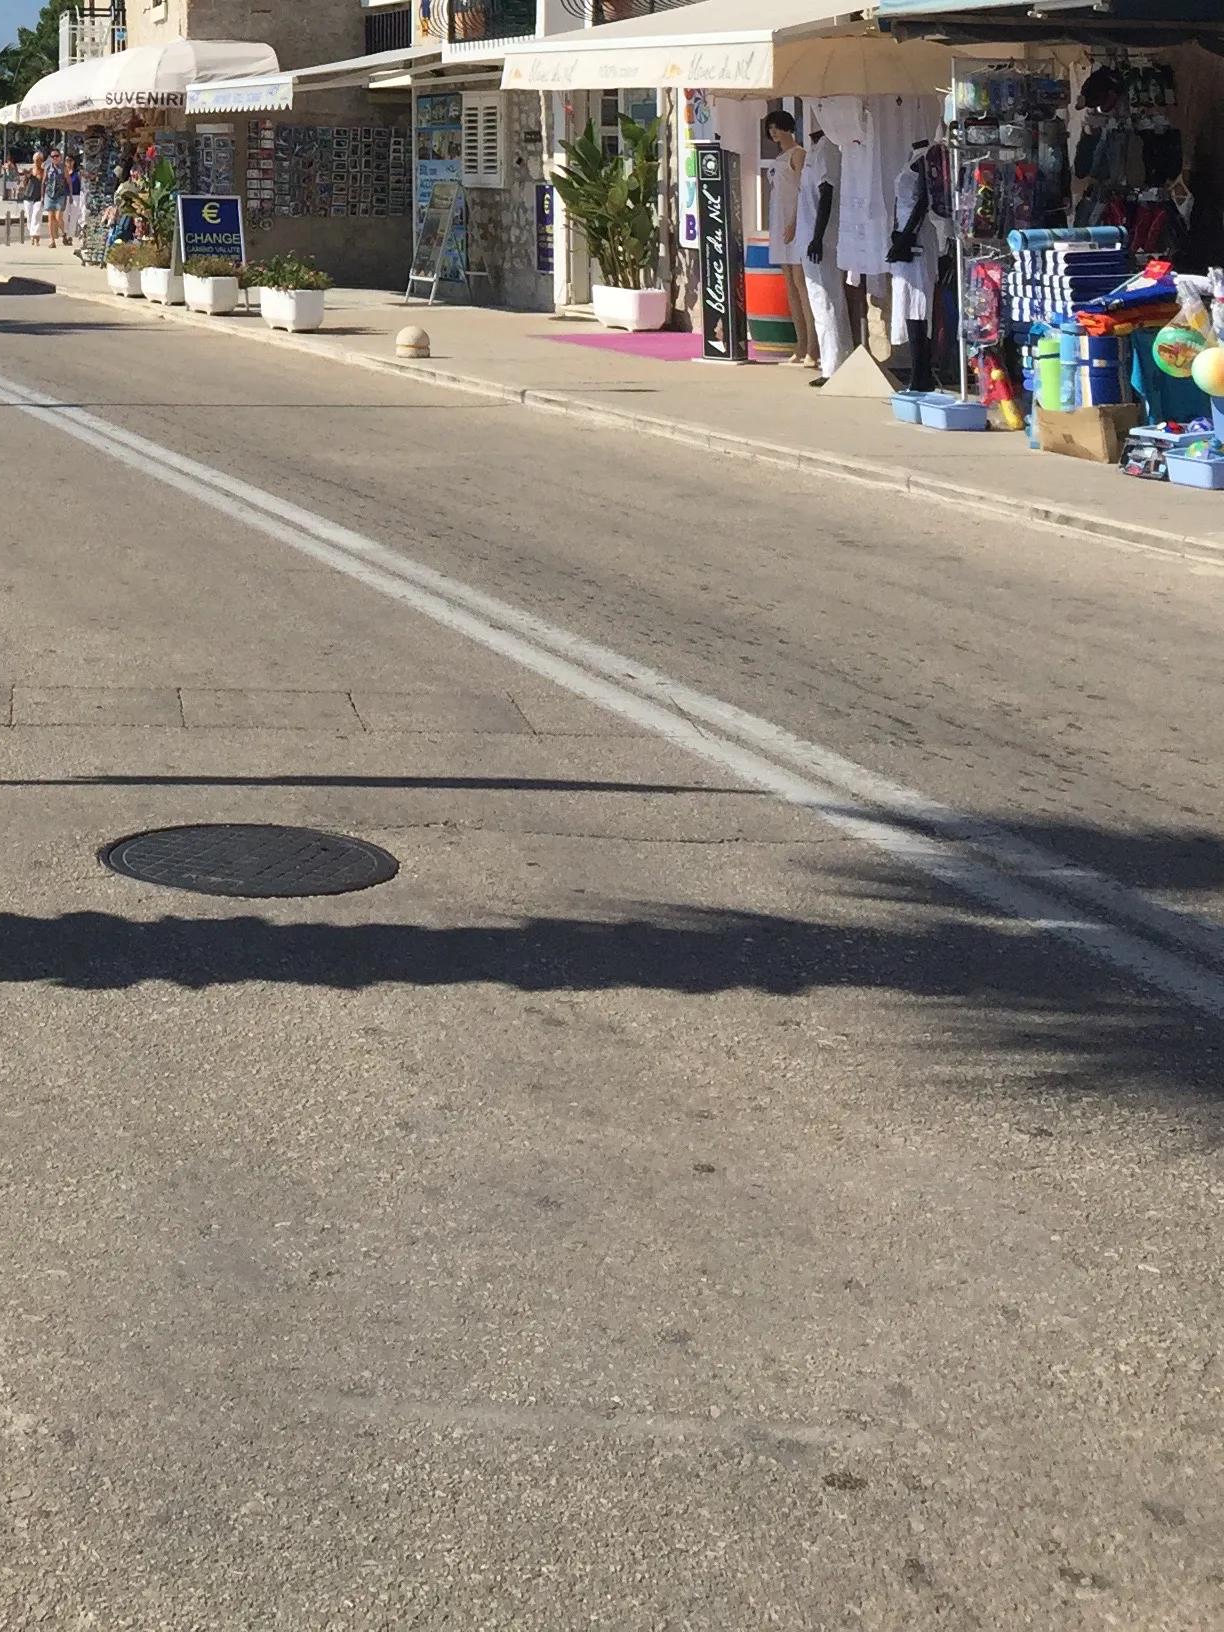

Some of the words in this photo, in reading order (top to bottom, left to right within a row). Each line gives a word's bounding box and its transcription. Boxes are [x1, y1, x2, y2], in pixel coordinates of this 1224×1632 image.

[105, 91, 184, 106] SUVENIRI
[702, 188, 724, 224] Nil
[185, 232, 241, 245] CHANGE
[705, 228, 724, 255] du
[705, 259, 725, 314] blanc
